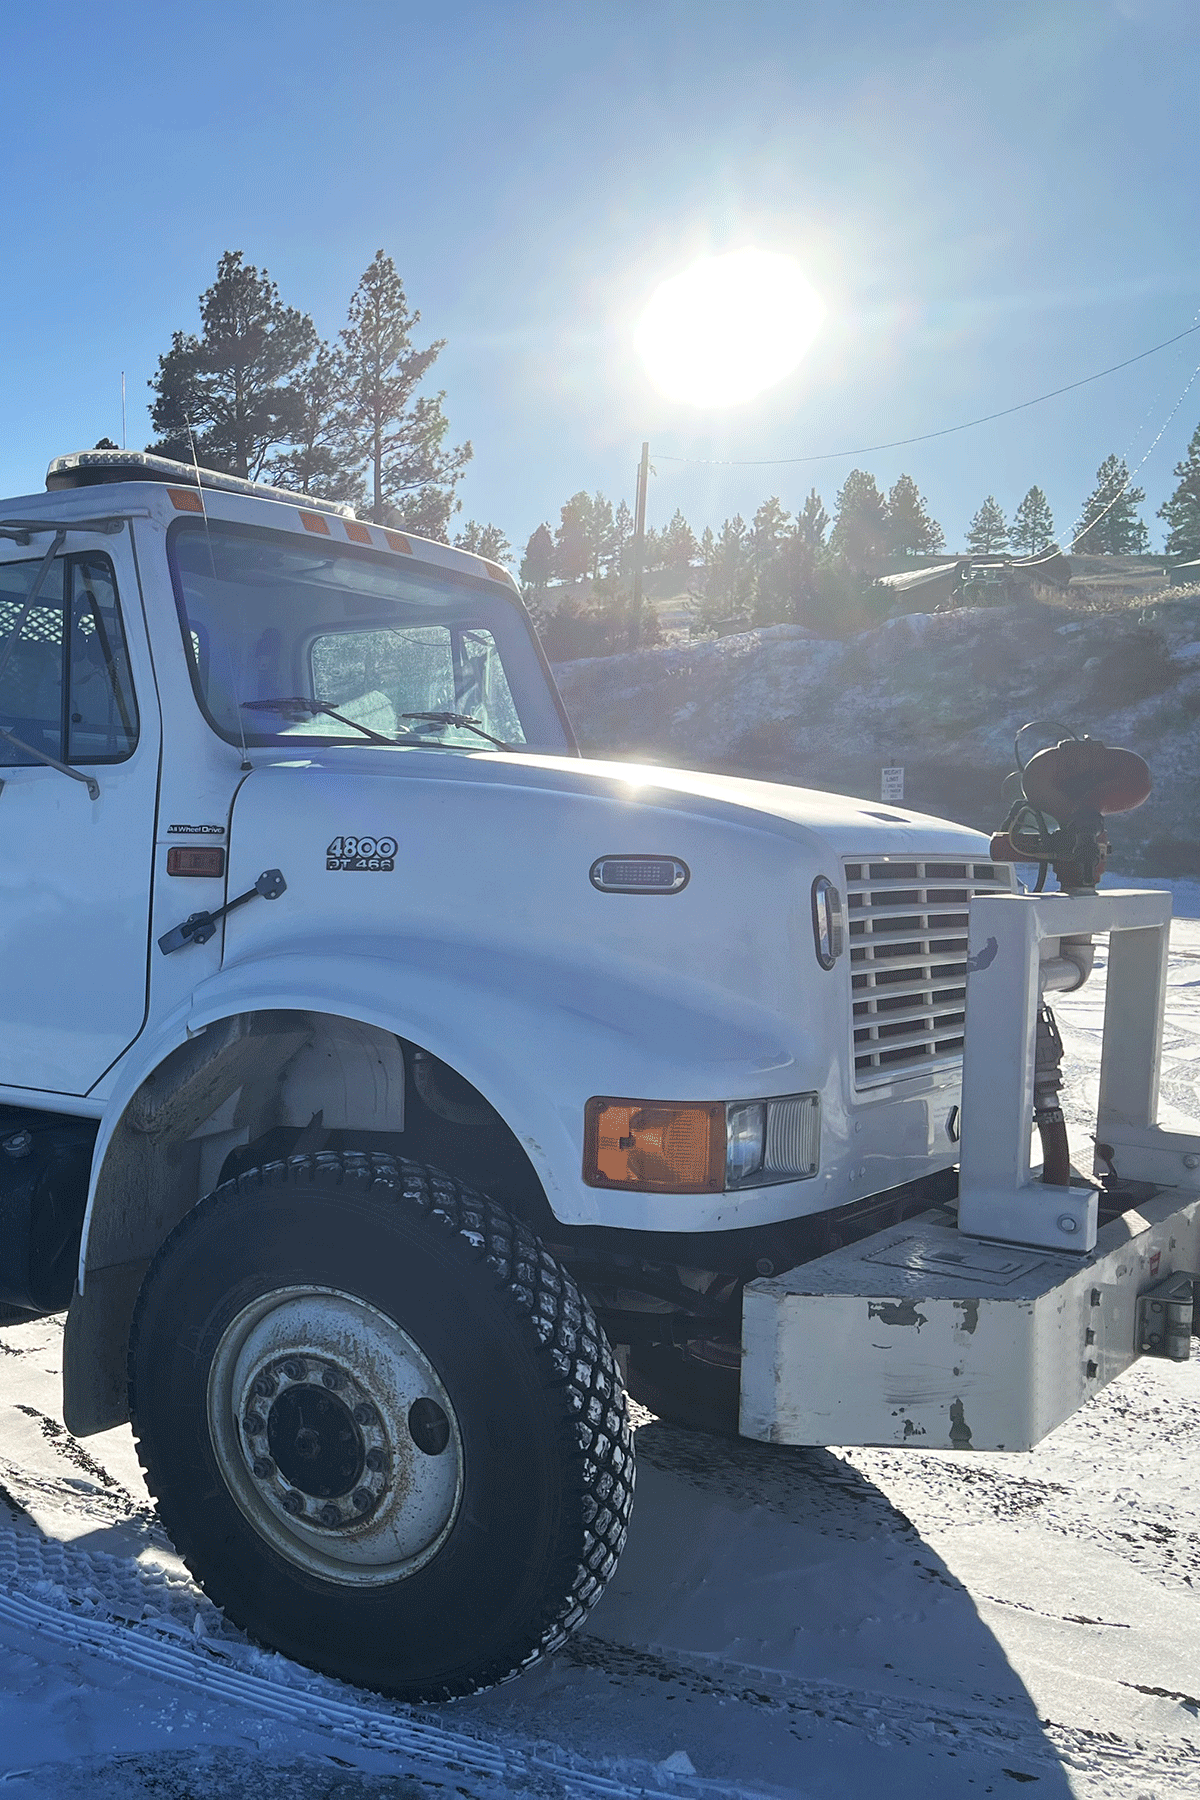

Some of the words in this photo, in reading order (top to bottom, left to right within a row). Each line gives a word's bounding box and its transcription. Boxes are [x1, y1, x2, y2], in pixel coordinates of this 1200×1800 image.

[179, 825, 201, 833] Wheel
[201, 825, 222, 833] Drive
[326, 836, 398, 858] 4800
[327, 859, 351, 870] DT
[355, 859, 392, 870] 466
